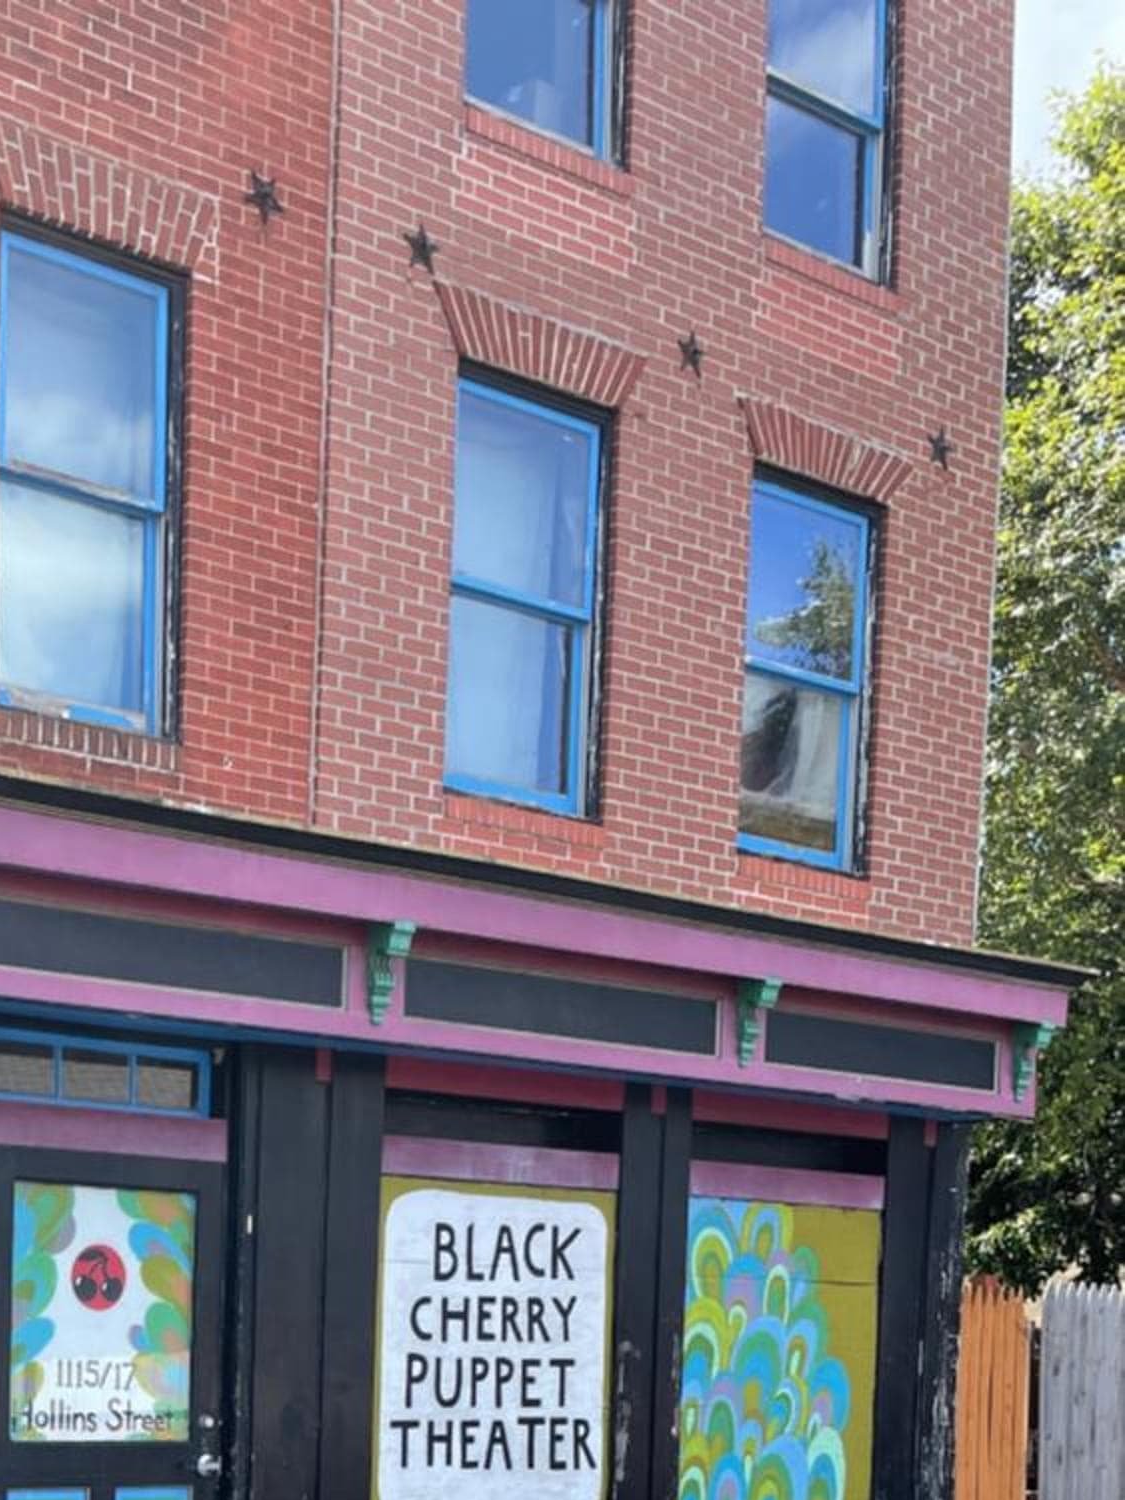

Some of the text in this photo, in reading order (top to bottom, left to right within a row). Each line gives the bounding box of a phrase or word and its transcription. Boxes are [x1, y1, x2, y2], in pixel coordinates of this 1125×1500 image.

[433, 1222, 581, 1281] BLACK
[410, 1296, 577, 1342] CHERRY
[56, 1359, 136, 1391] 1115/17
[405, 1353, 576, 1409] PUPPET
[105, 1398, 174, 1432] Street
[390, 1416, 597, 1471] THEATER
